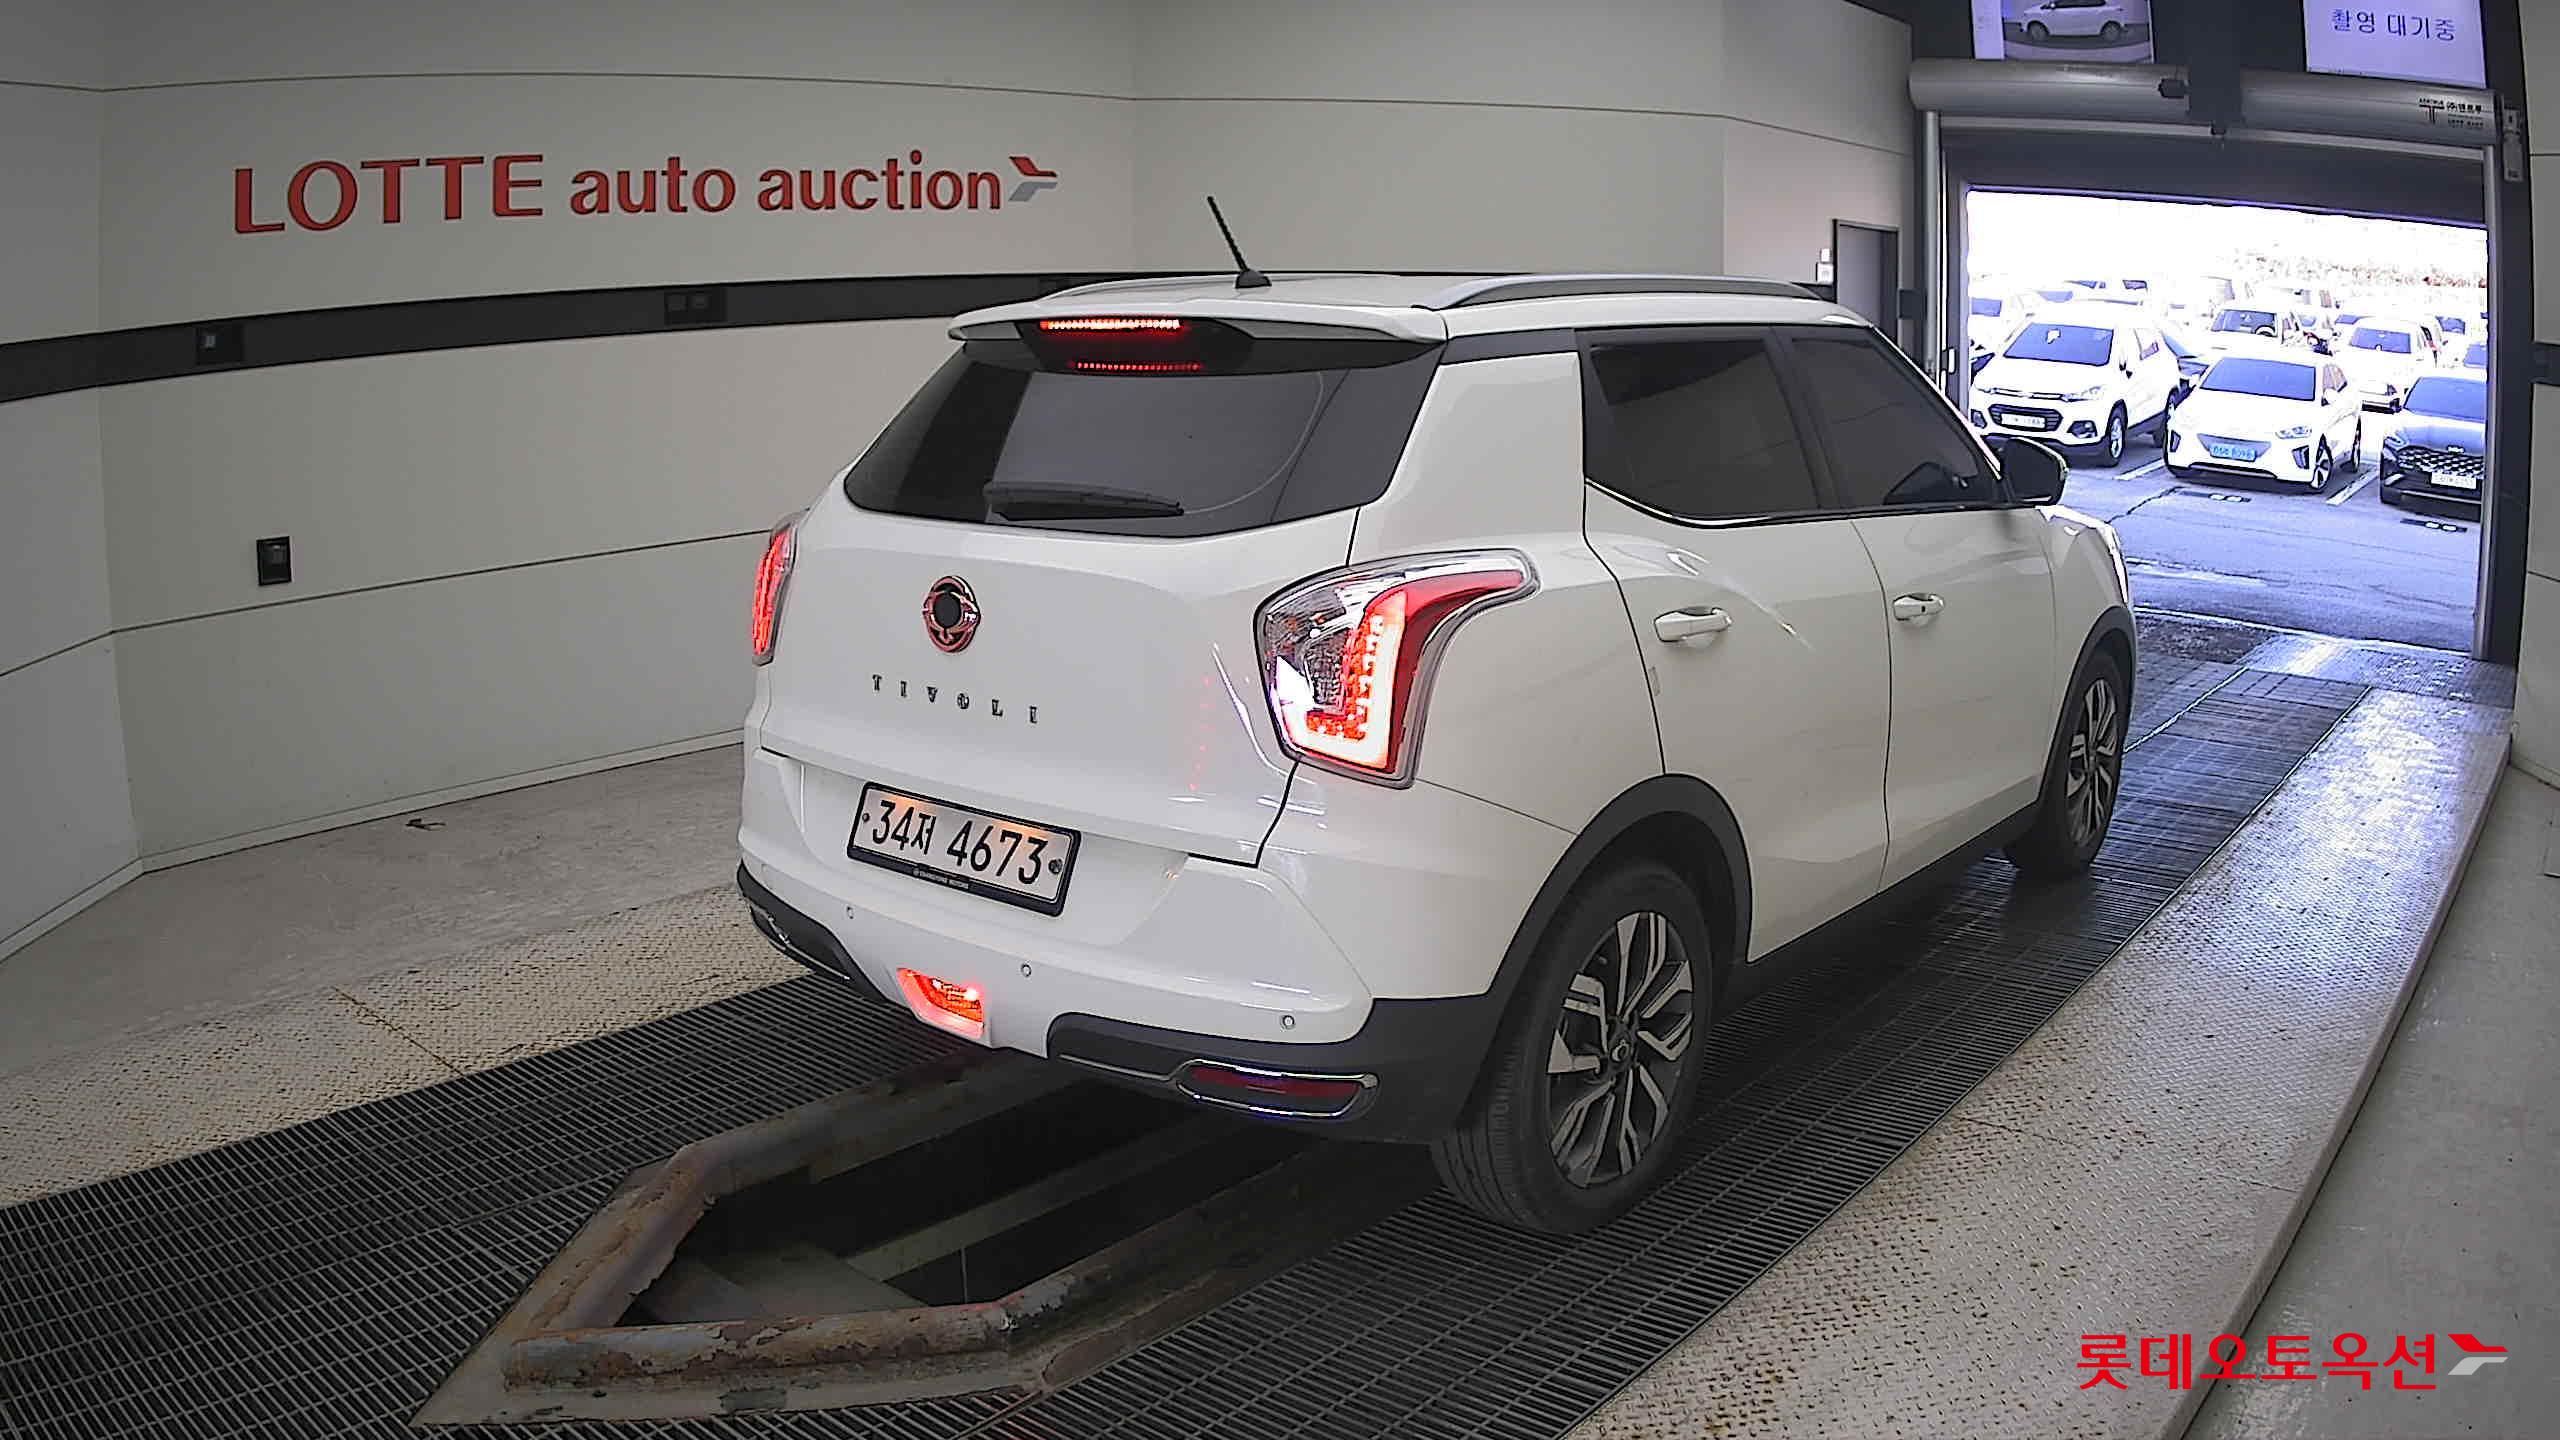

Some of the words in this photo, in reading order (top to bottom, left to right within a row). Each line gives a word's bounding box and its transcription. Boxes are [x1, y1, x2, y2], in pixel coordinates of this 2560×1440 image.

[2332, 9, 2375, 33] 촬영
[2387, 14, 2455, 41] 대기중
[235, 154, 543, 234] LOTTE
[569, 156, 736, 215] auto
[757, 149, 1001, 211] auction
[872, 674, 1038, 724] TIVOLI
[872, 799, 937, 855] 34저
[947, 820, 1049, 885] 4673
